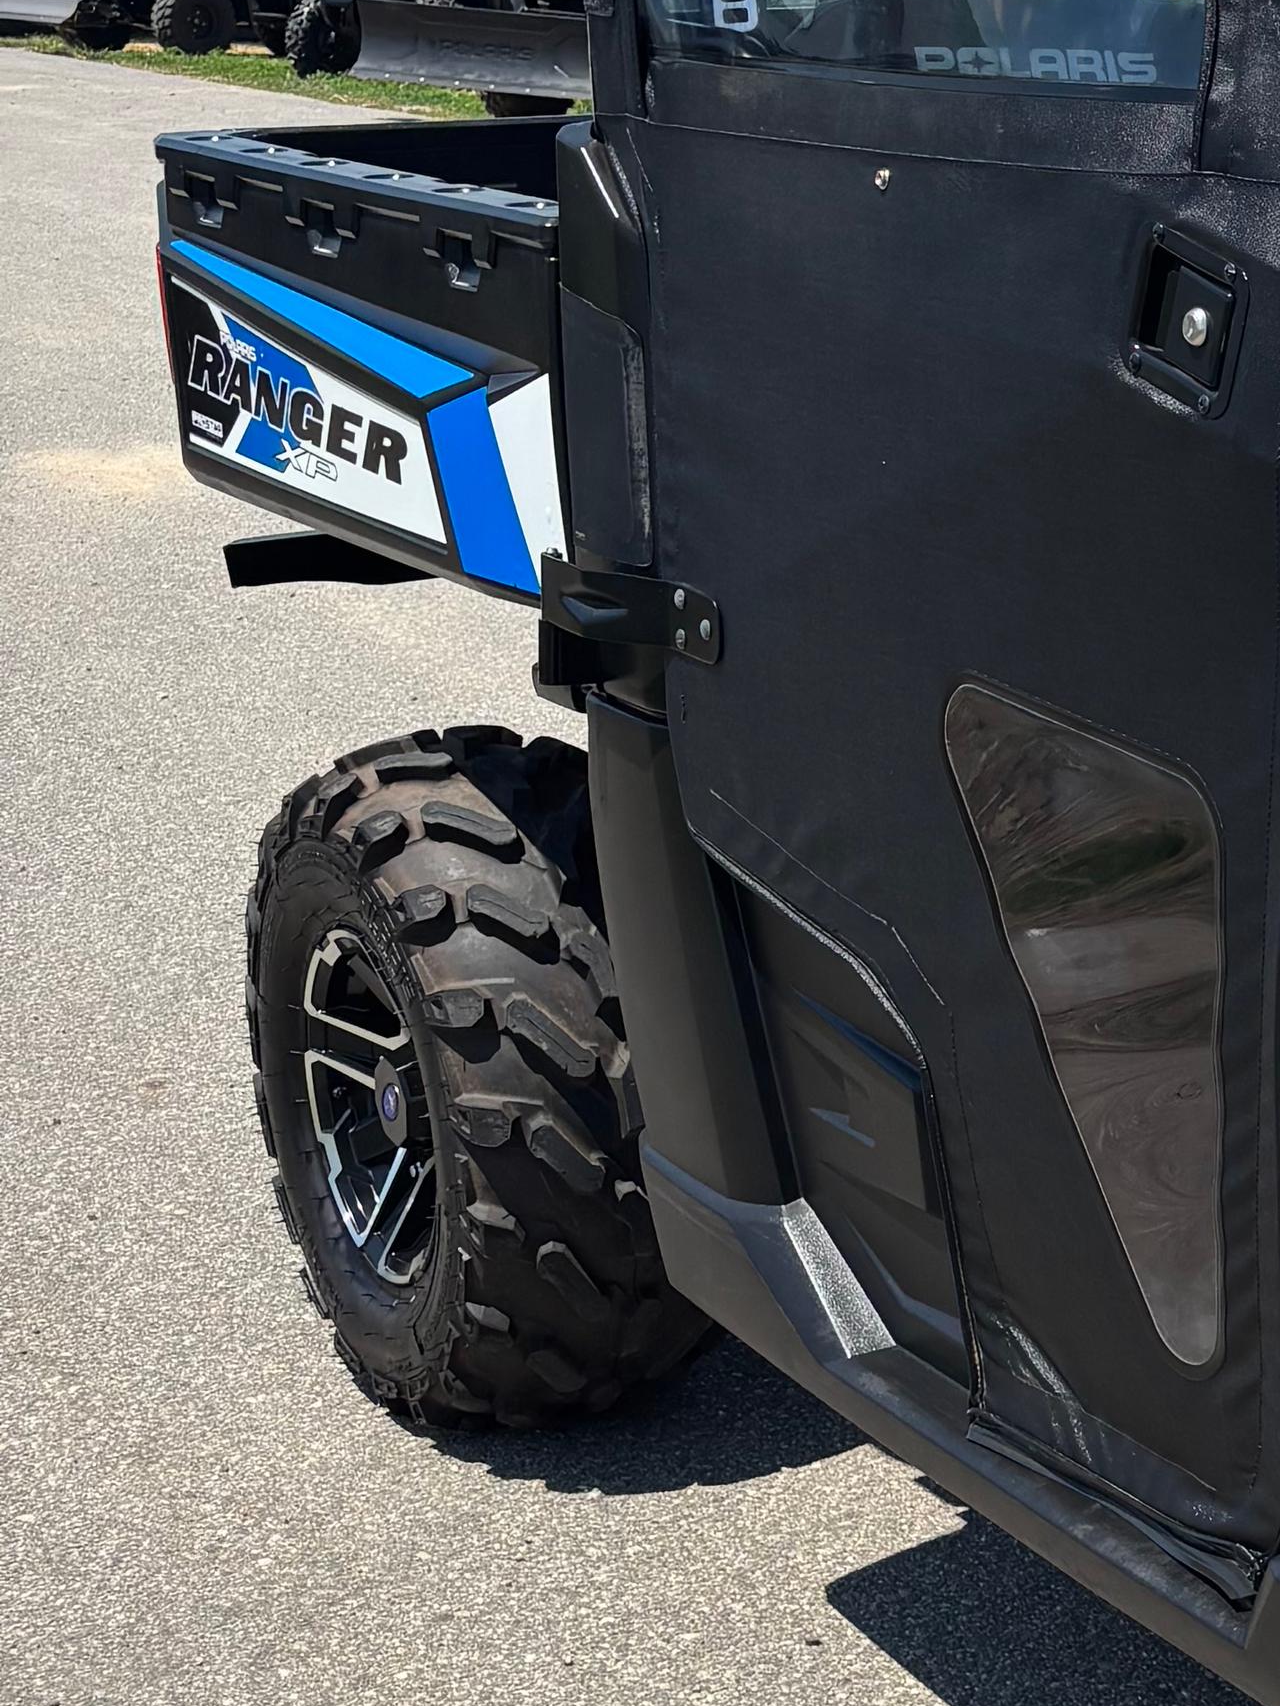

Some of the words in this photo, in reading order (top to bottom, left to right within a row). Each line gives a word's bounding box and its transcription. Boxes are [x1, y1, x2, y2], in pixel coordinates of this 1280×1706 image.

[914, 46, 1157, 84] POLARIS
[188, 335, 407, 485] RANGER
[276, 439, 338, 482] XP
